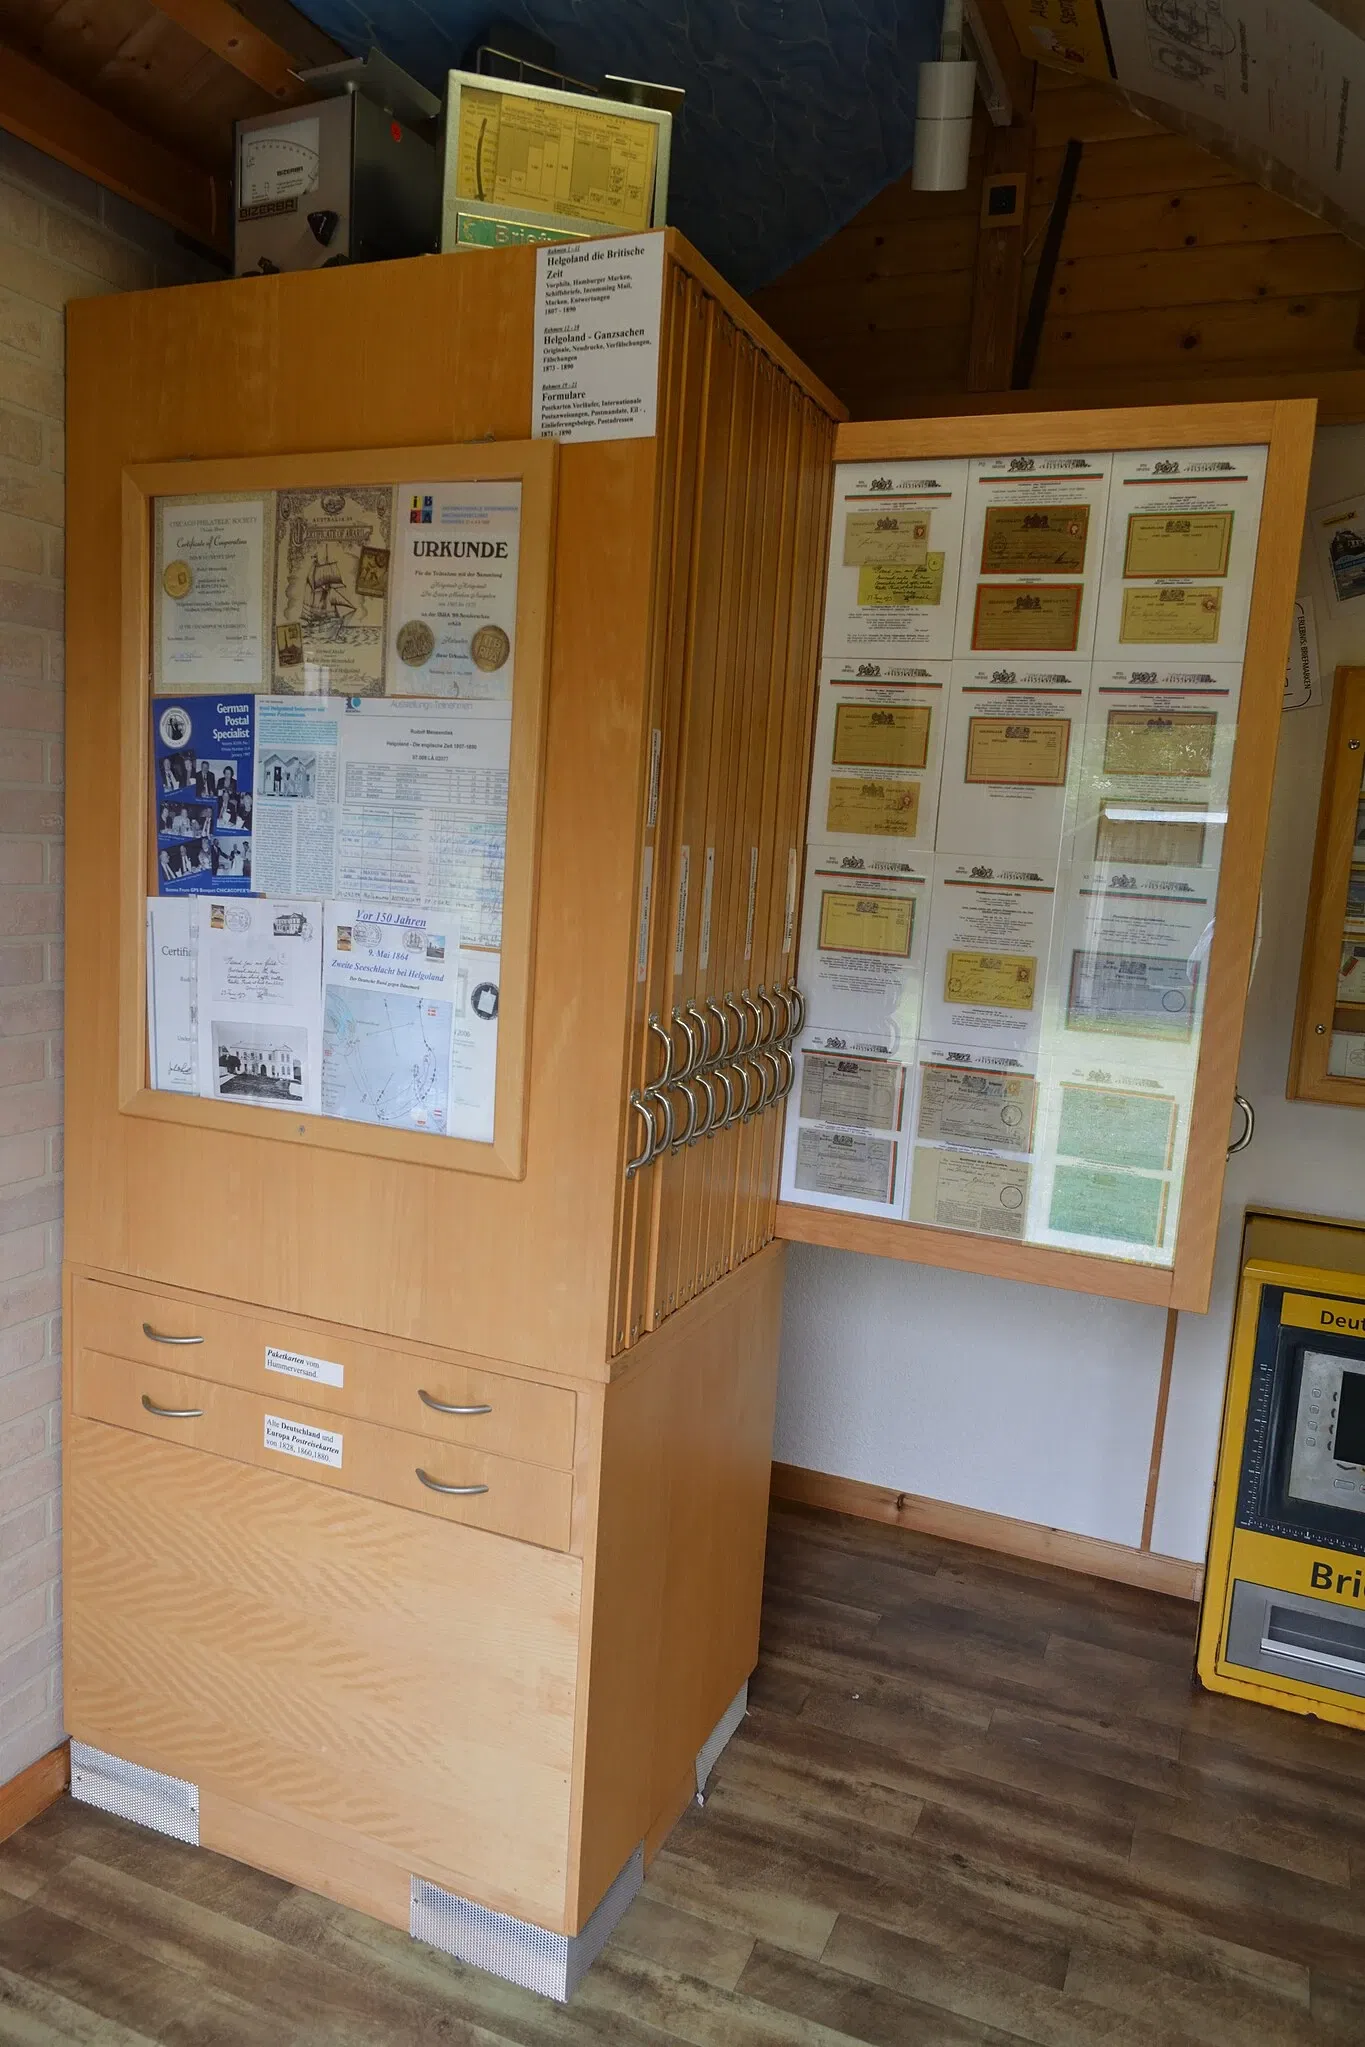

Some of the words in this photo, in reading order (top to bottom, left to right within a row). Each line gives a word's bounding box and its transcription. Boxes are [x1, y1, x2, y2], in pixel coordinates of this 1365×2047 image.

[239, 199, 298, 219] BIZERBA
[547, 253, 589, 267] Helgoland
[591, 252, 605, 262] die
[607, 246, 645, 259] Britische
[546, 270, 563, 280] Zeit
[573, 277, 606, 286] Hamburger
[570, 295, 610, 304] Entwertungen
[563, 306, 577, 314] 1890
[543, 333, 586, 346] Helgoland
[594, 328, 645, 341] Ganzsachen
[543, 347, 571, 355] Originale,
[572, 343, 605, 352] Neudrucke,
[560, 363, 574, 371] 1890
[542, 390, 586, 402] Formulare
[601, 397, 642, 407] Internationale
[597, 416, 634, 426] Postadressen
[558, 428, 572, 437] 1890
[176, 536, 205, 549] Certificate
[413, 540, 509, 560] URKUNDE
[1297, 615, 1307, 645] ERLEBNIS:
[1301, 645, 1312, 690] BRIEFMARKEN
[217, 703, 249, 714] German
[224, 715, 249, 726] Postal
[212, 728, 250, 742] Specialist
[356, 909, 374, 921] Vor
[376, 912, 393, 923] 150
[394, 915, 427, 927] Jahren
[368, 949, 375, 957] 9.
[376, 950, 391, 959] Mai
[392, 953, 409, 961] 1864
[331, 960, 354, 970] Zweite
[355, 962, 396, 975] Seeschlacht
[396, 968, 407, 977] bei
[408, 970, 445, 982] Helgoland
[267, 1349, 305, 1365] Paketkarten
[306, 1361, 320, 1369] vom
[267, 1359, 318, 1378] Hummerversand.
[266, 1419, 280, 1429] Alte
[281, 1422, 321, 1439] Deutschland
[322, 1434, 334, 1443] und
[266, 1428, 290, 1441] Europa
[291, 1435, 340, 1454] Postreisekarten
[266, 1439, 278, 1447] von
[279, 1441, 296, 1453] 1828,
[1310, 1561, 1365, 1599] Bri
